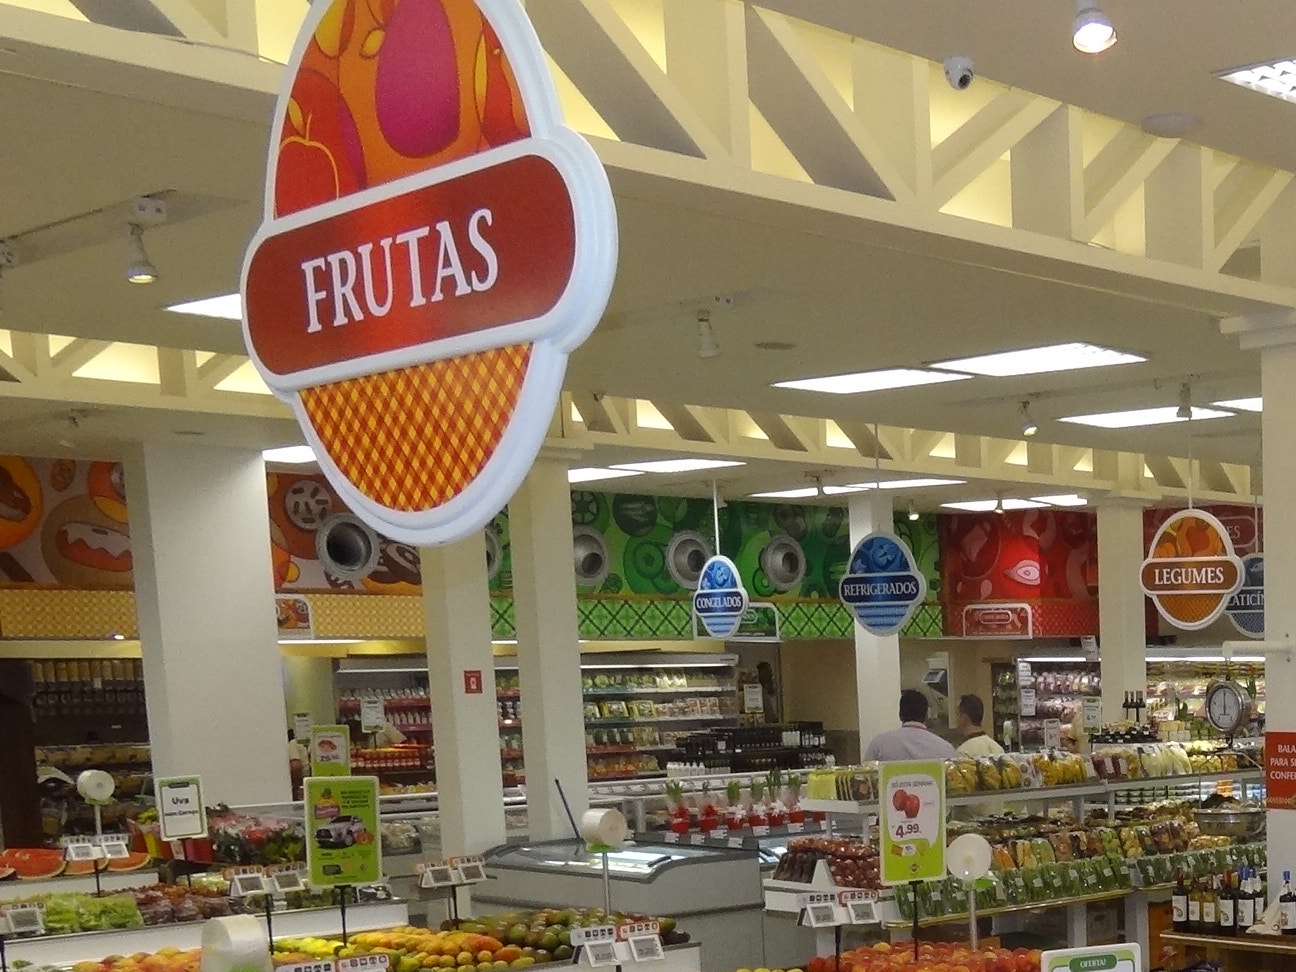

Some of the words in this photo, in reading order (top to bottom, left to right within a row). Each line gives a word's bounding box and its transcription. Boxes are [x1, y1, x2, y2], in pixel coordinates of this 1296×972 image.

[301, 208, 498, 333] FRUTAS
[1154, 567, 1225, 585] LEGUMES
[843, 581, 918, 597] REFRIGERADOS
[696, 596, 742, 610] CONGELADOS
[1270, 758, 1289, 767] PARA
[171, 797, 190, 805] Uva
